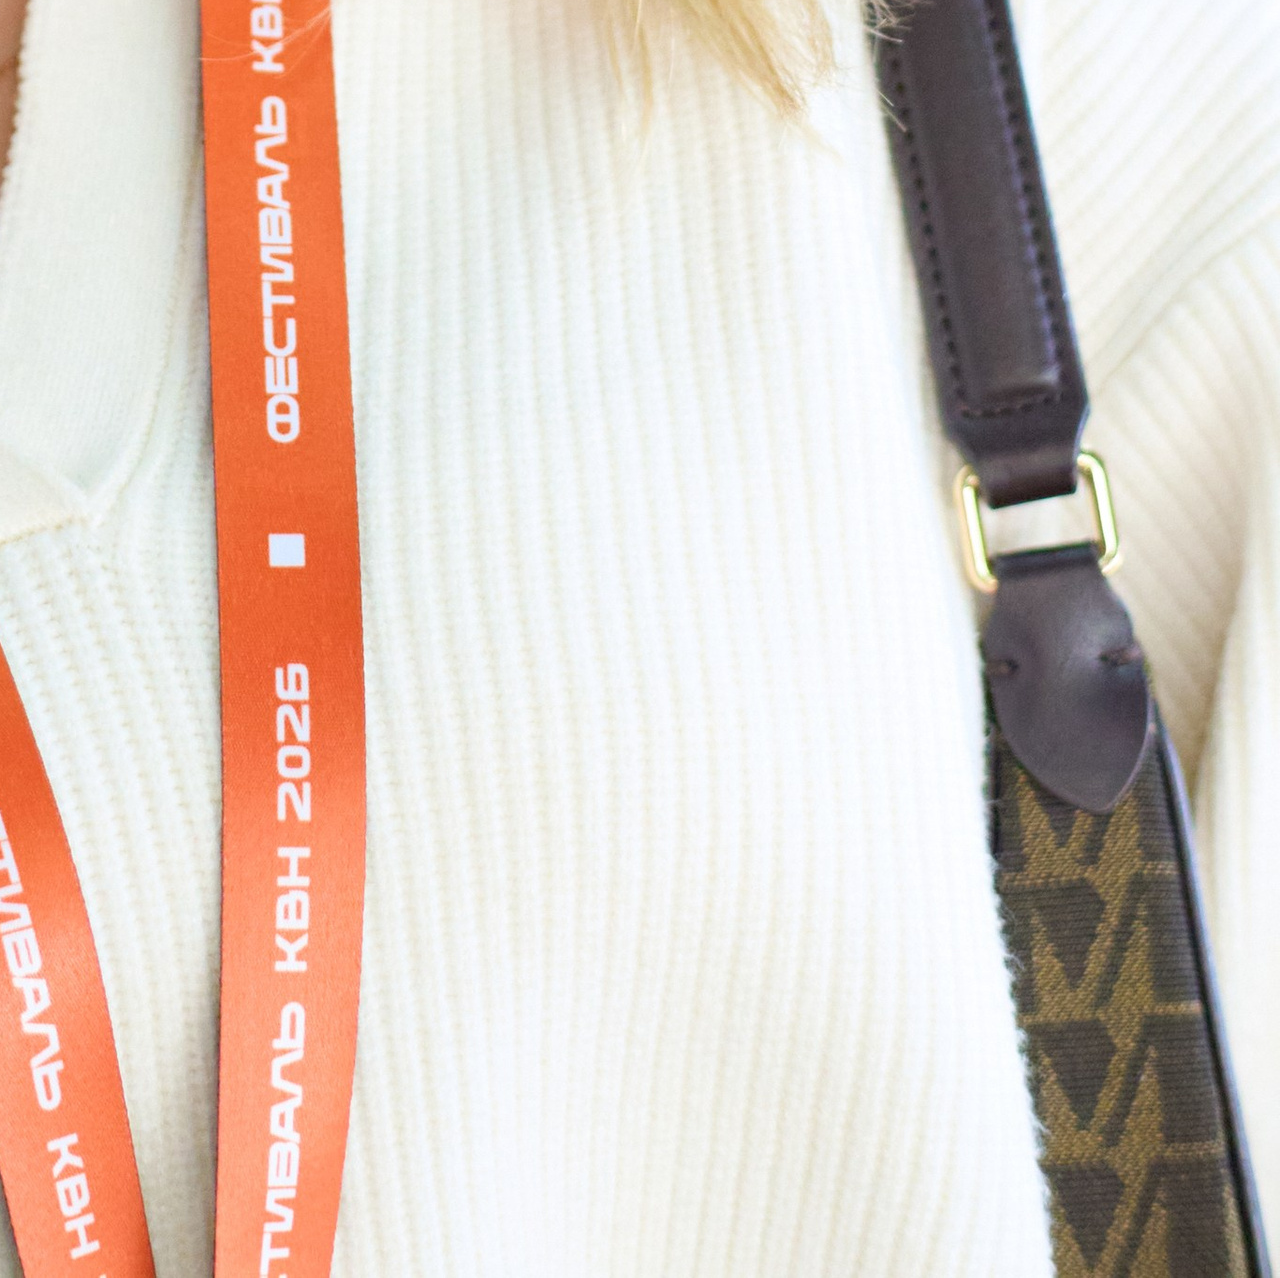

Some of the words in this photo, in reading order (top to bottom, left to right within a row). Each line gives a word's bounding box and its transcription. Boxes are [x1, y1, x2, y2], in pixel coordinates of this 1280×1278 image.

[254, 95, 301, 444] ФЕСТИВАЛЬ
[274, 662, 313, 823] 2026
[273, 845, 312, 974] КВН
[45, 1131, 102, 1261] КВН
[258, 1000, 308, 1278] ТИВАЛЬ
